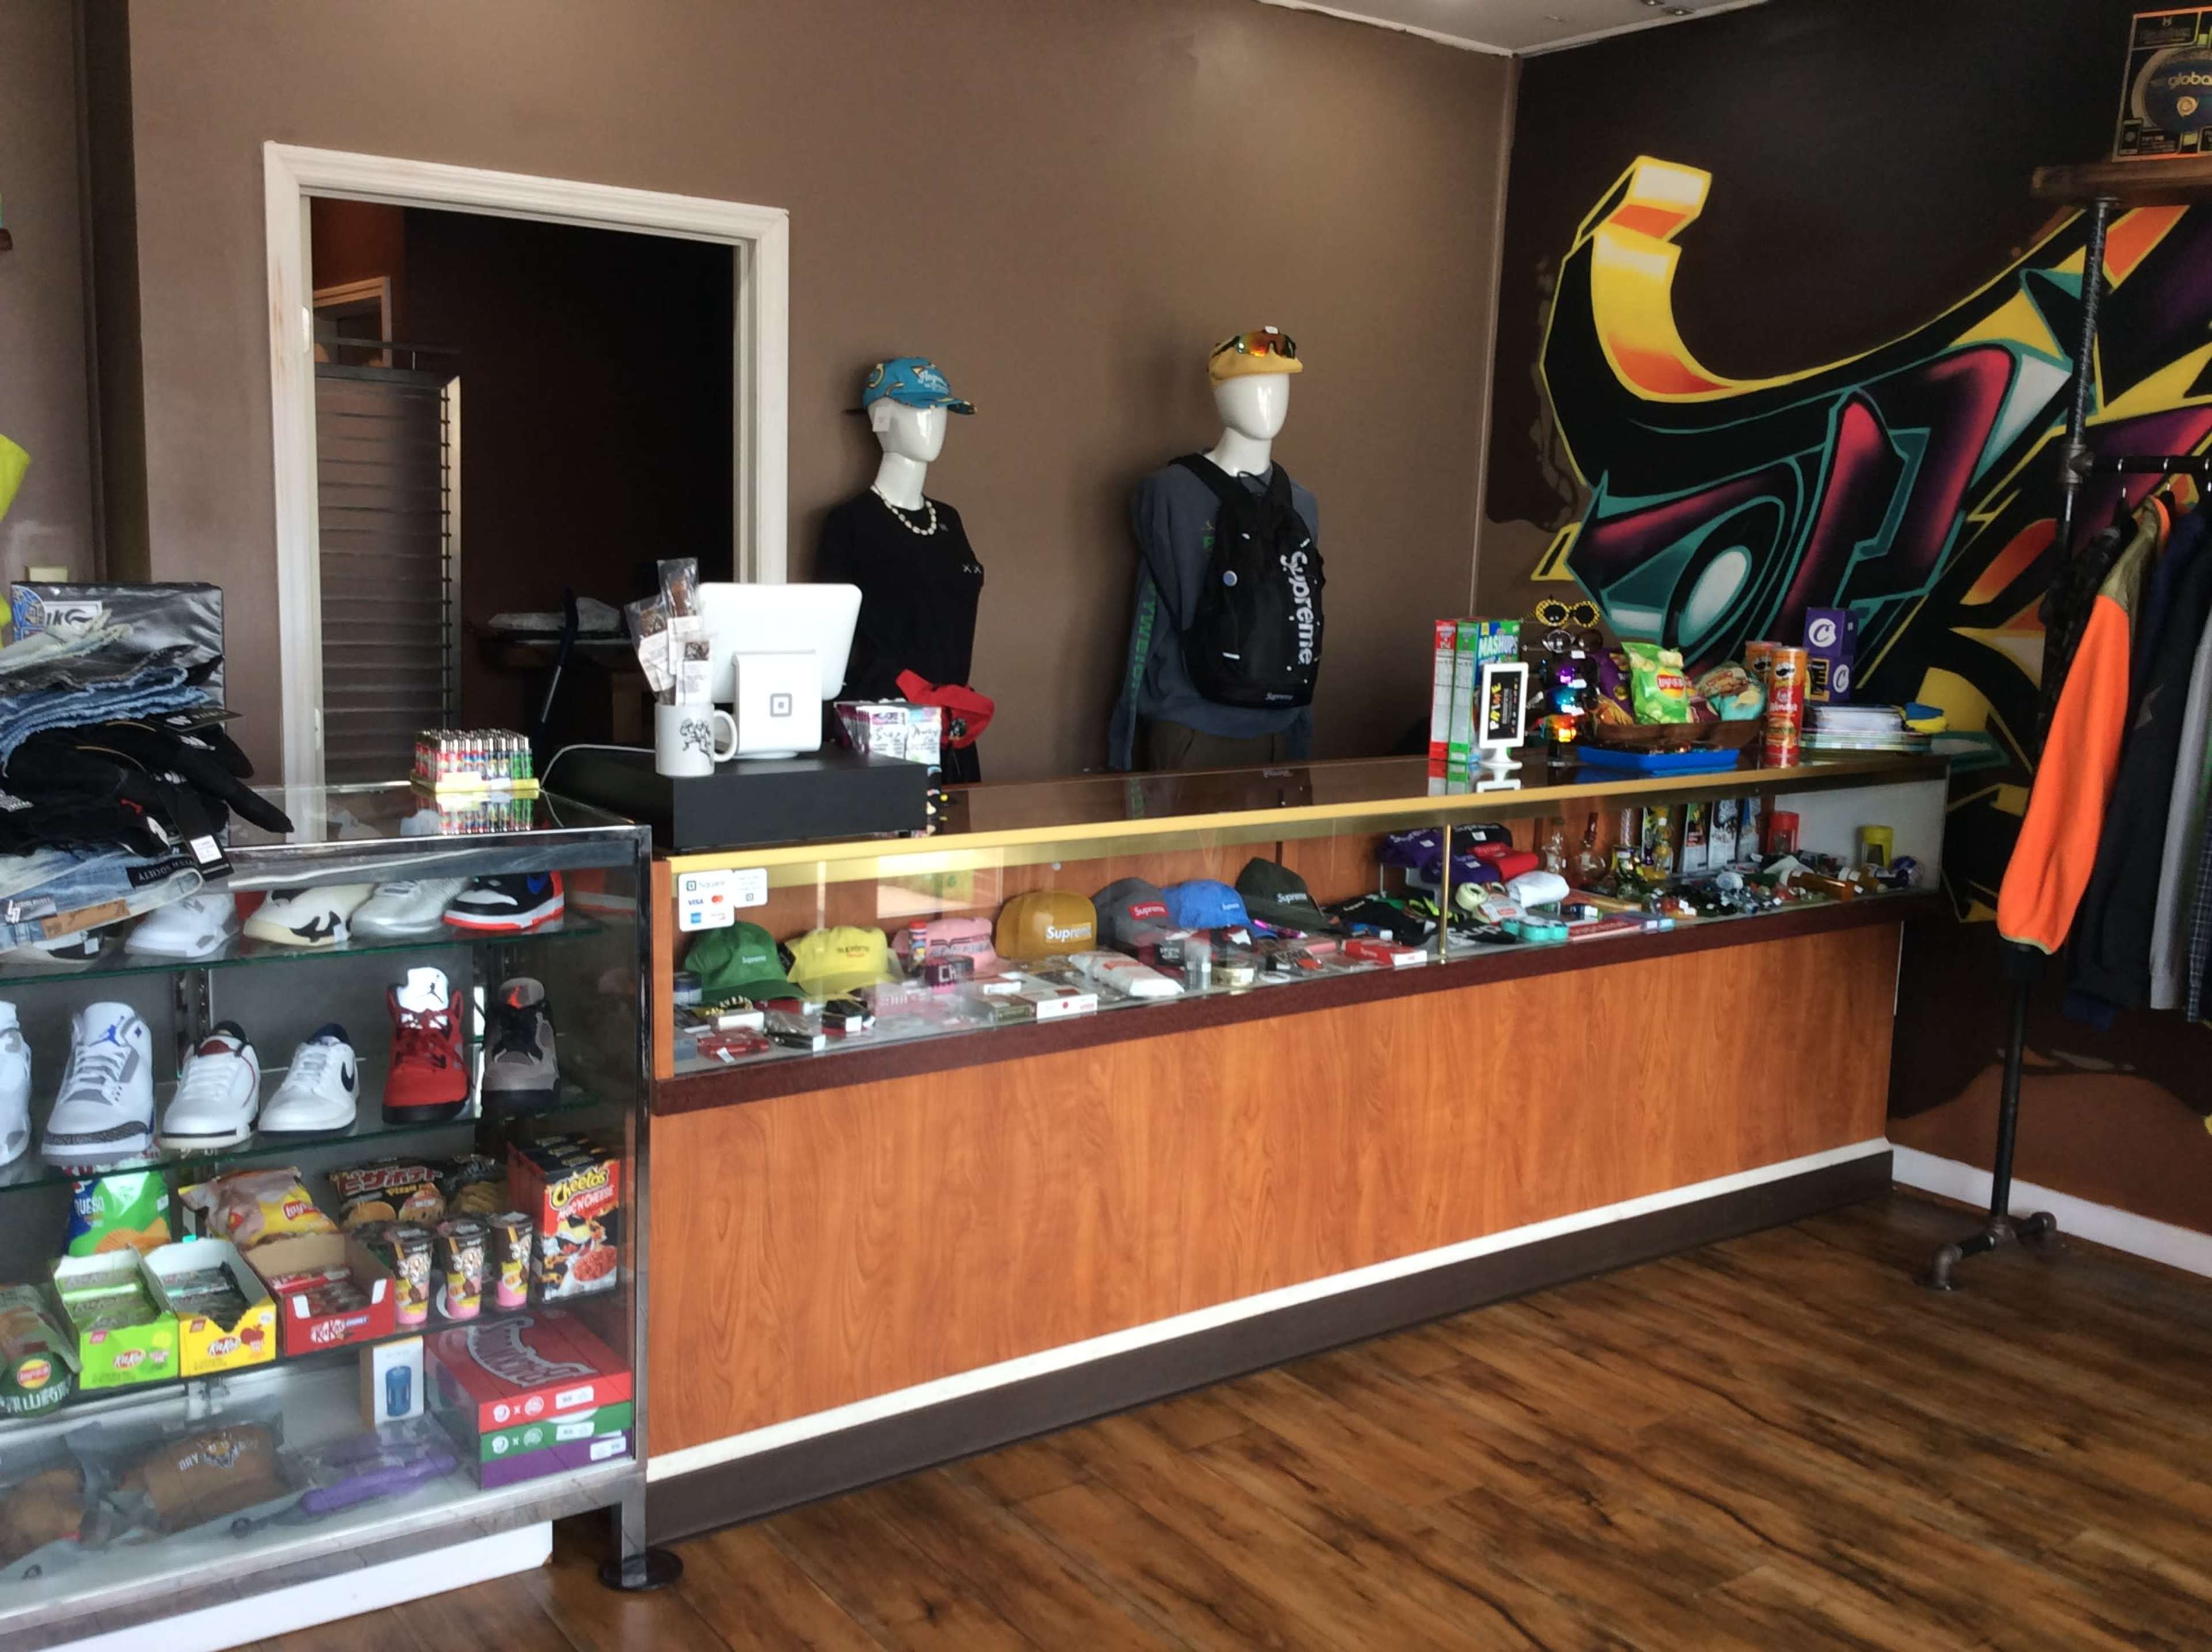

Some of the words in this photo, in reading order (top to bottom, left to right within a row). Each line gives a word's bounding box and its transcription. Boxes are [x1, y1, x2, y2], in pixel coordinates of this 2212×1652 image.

[2168, 71, 2212, 89] globa
[1280, 551, 1315, 665] Supreme
[1133, 906, 1166, 916] Supreme
[1046, 924, 1092, 942] Supreme
[552, 1169, 607, 1208] Cheetos
